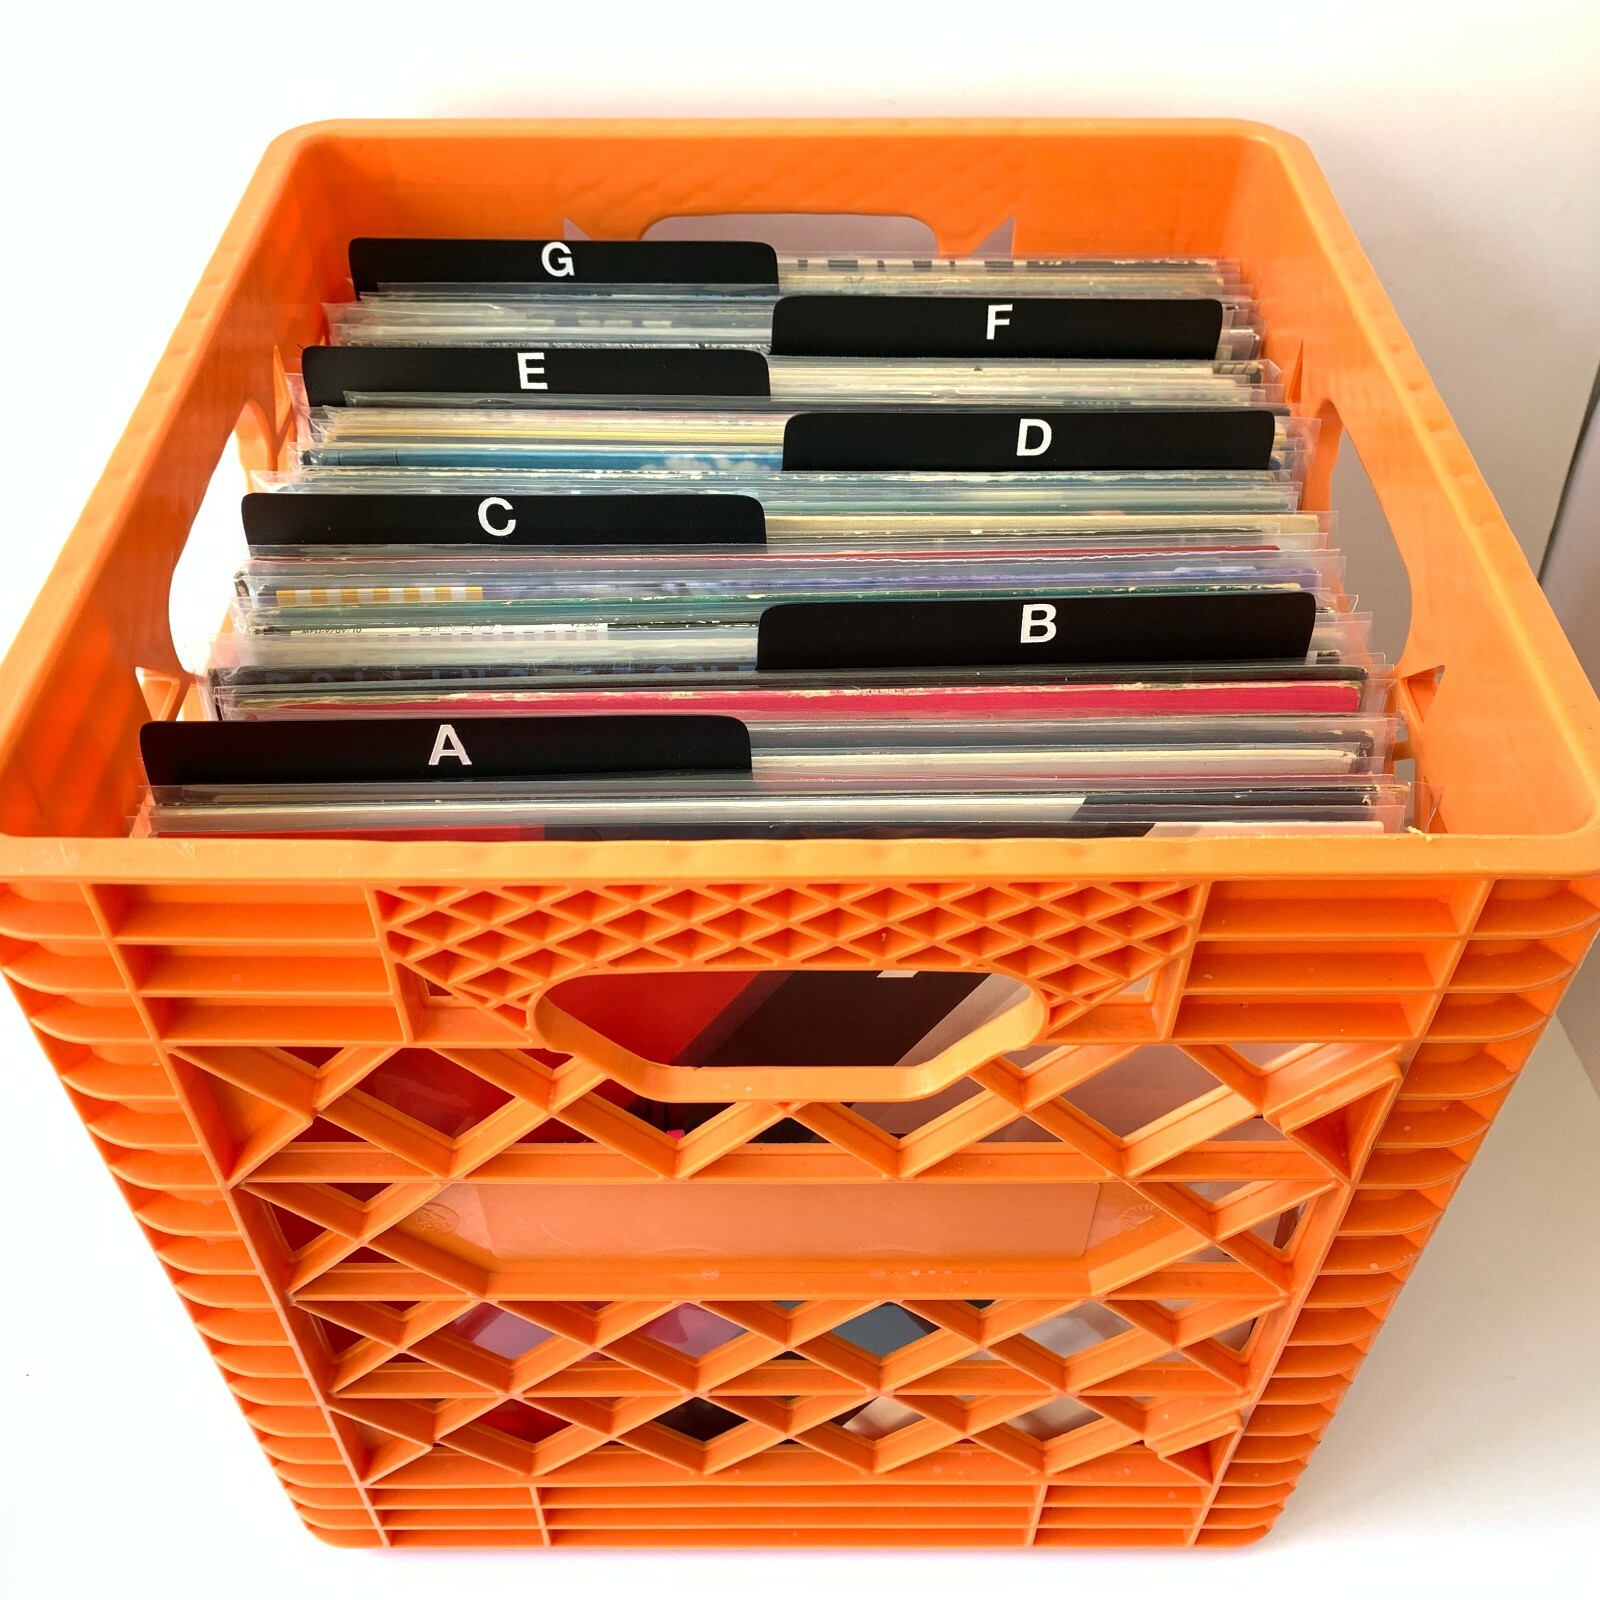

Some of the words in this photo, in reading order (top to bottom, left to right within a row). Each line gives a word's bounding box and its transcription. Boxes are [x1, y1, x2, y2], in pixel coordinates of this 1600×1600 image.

[541, 241, 575, 278] G
[986, 303, 1014, 341] F
[517, 351, 549, 390] E
[1016, 418, 1053, 457] D
[477, 496, 517, 537] C
[1020, 603, 1057, 644] B
[428, 724, 473, 766] A
